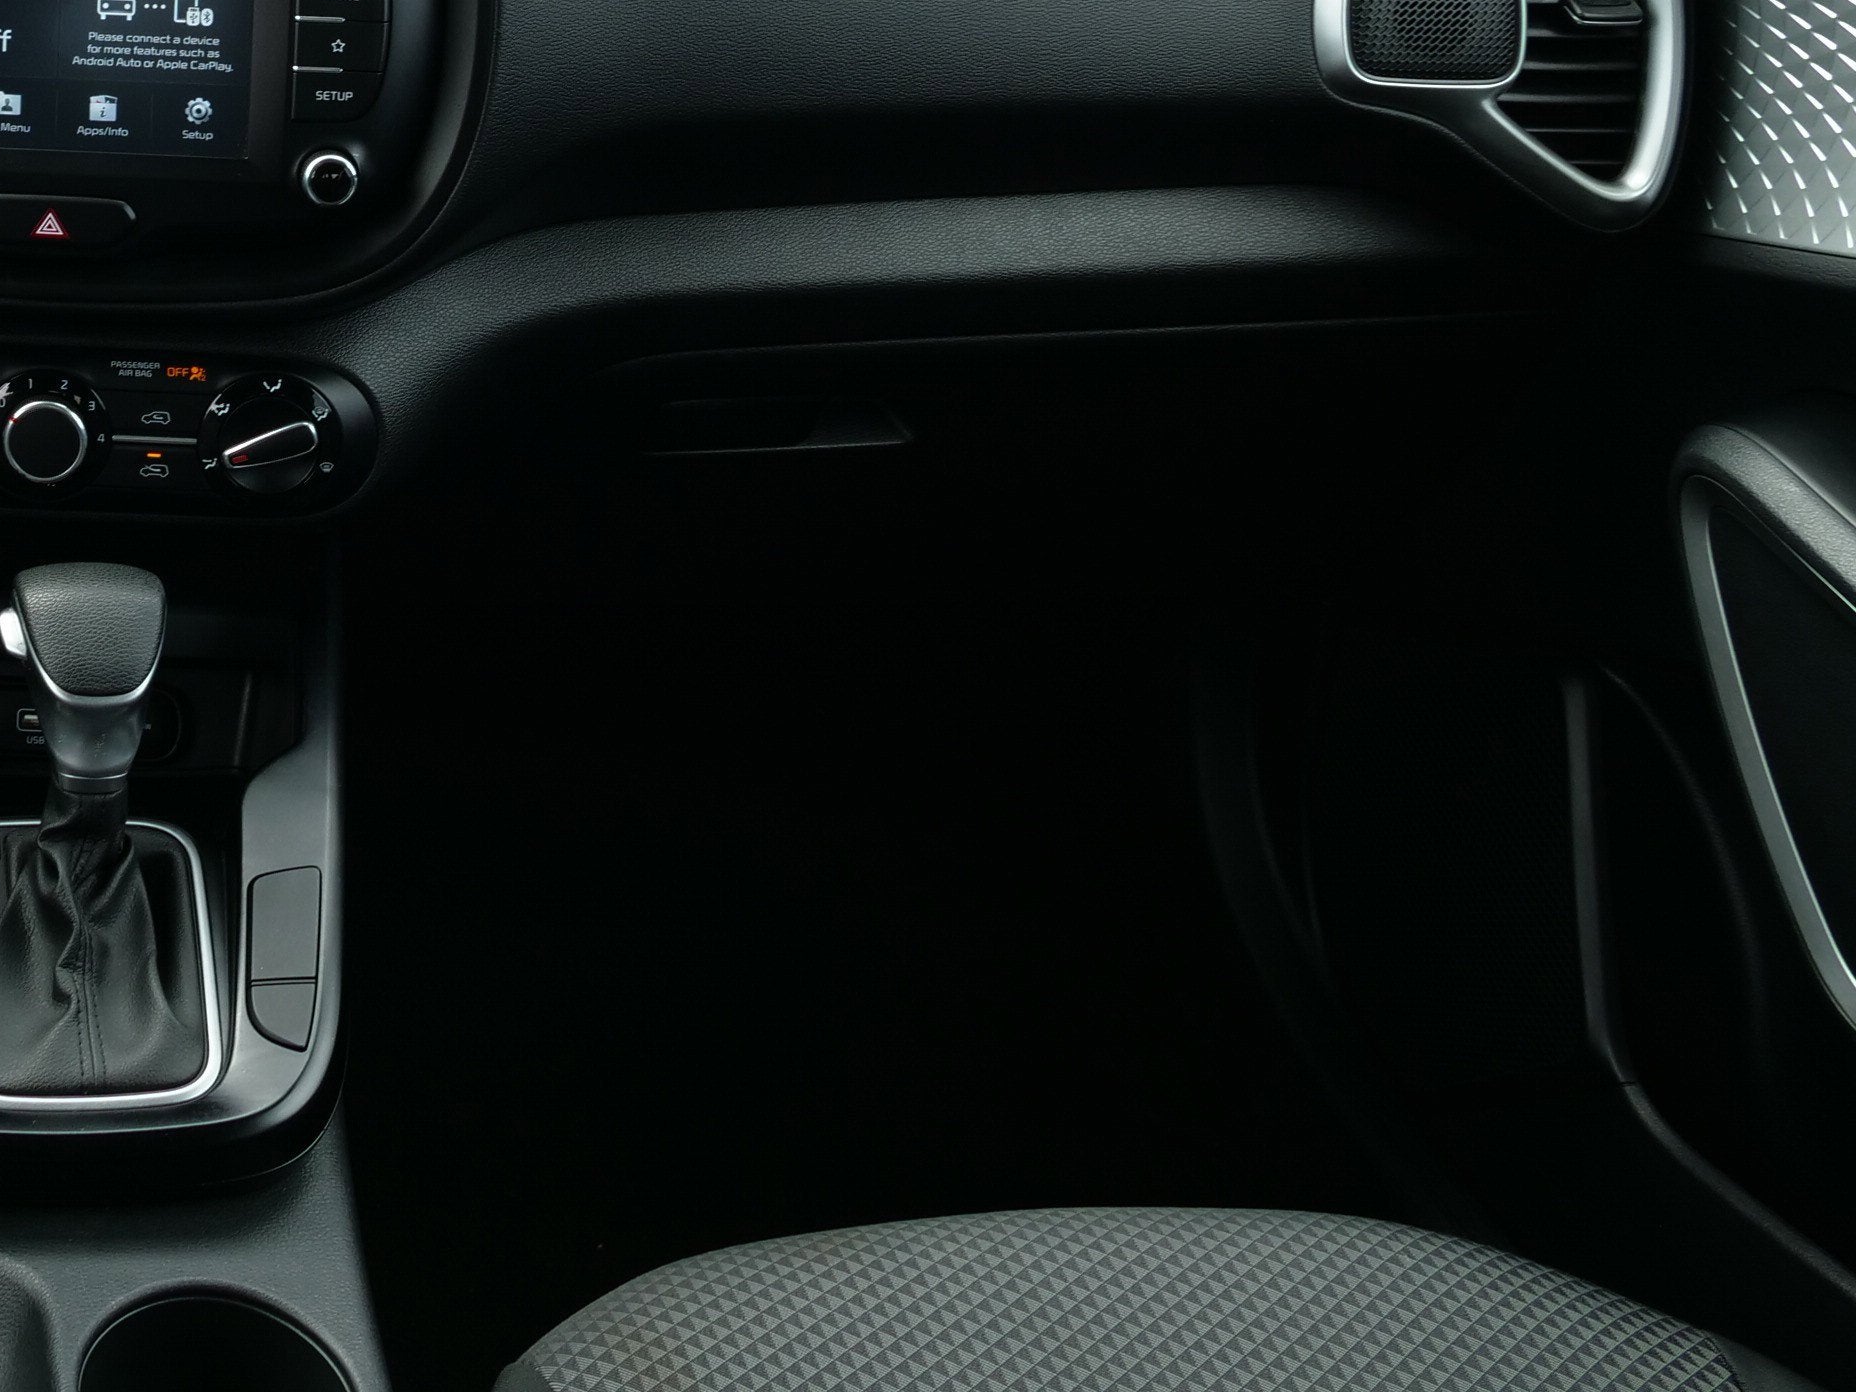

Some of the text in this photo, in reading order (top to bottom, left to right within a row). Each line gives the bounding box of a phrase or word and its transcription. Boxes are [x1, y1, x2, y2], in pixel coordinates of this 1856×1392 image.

[88, 31, 220, 46] Please connect a device
[87, 44, 220, 59] for more features such as
[72, 56, 234, 73] Android Auto or Apple CarPlay.
[315, 90, 353, 102] SETUP
[0, 122, 32, 134] Menu
[77, 125, 129, 139] Apps/Info
[182, 129, 214, 142] Setup
[111, 361, 161, 370] PASSENGER
[118, 369, 153, 378] AIR BAG
[166, 367, 189, 377] OFF
[60, 379, 69, 390] 2
[88, 400, 96, 411] 3
[97, 433, 105, 443] 4
